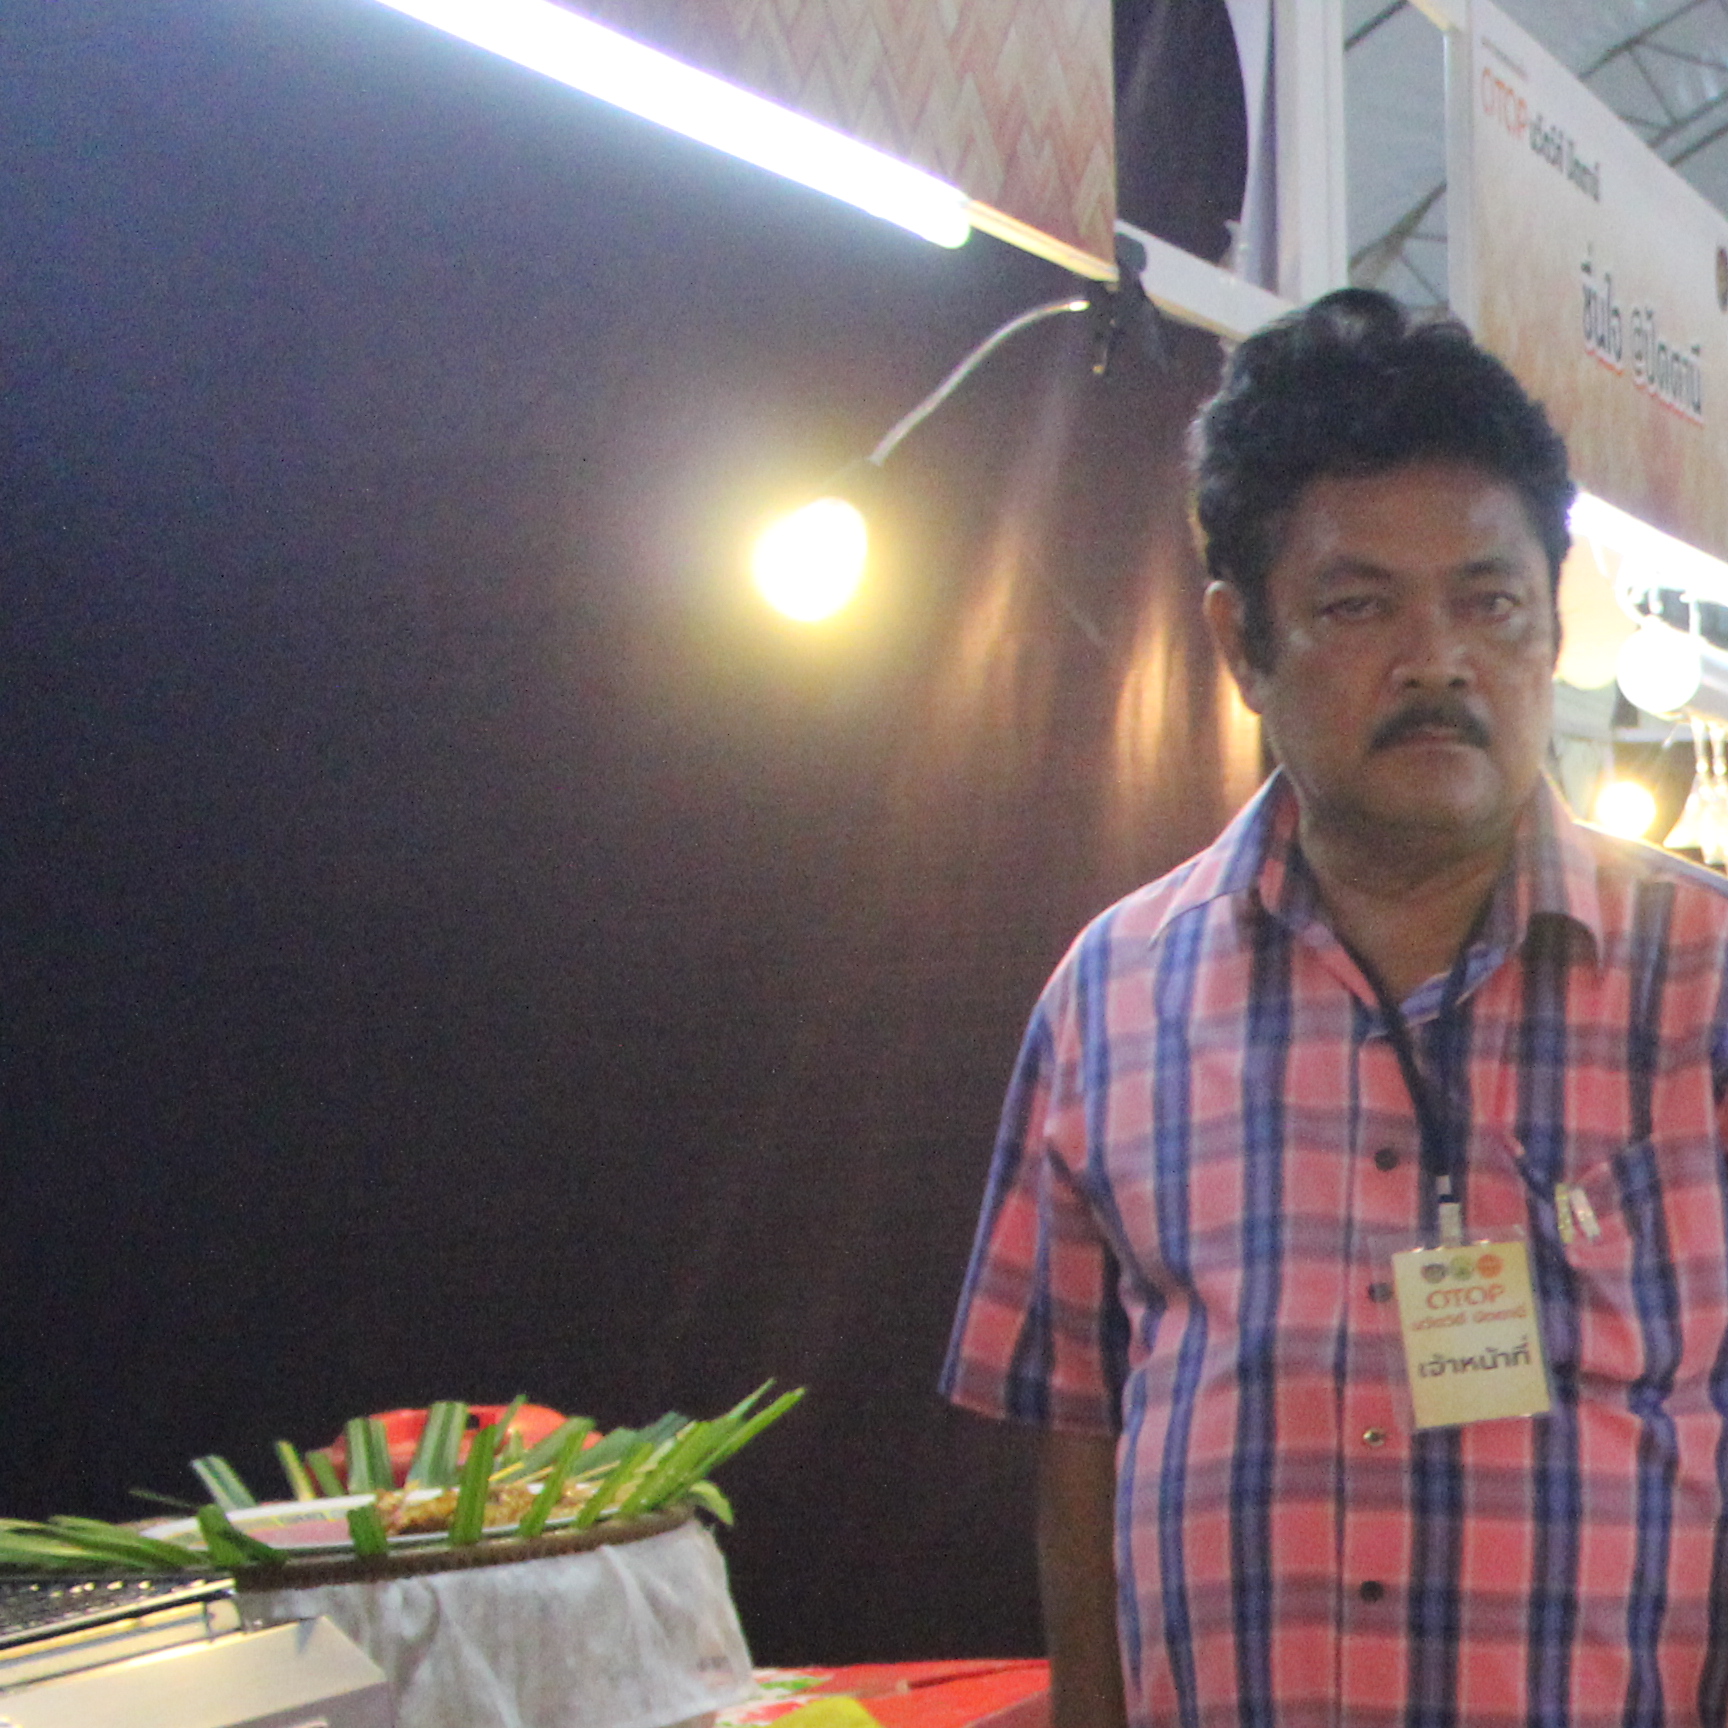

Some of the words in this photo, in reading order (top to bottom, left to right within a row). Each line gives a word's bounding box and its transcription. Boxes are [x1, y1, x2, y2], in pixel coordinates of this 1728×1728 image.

[1426, 1283, 1505, 1310] OTOP
[1417, 1335, 1531, 1379] เจ้าหน้าที่
